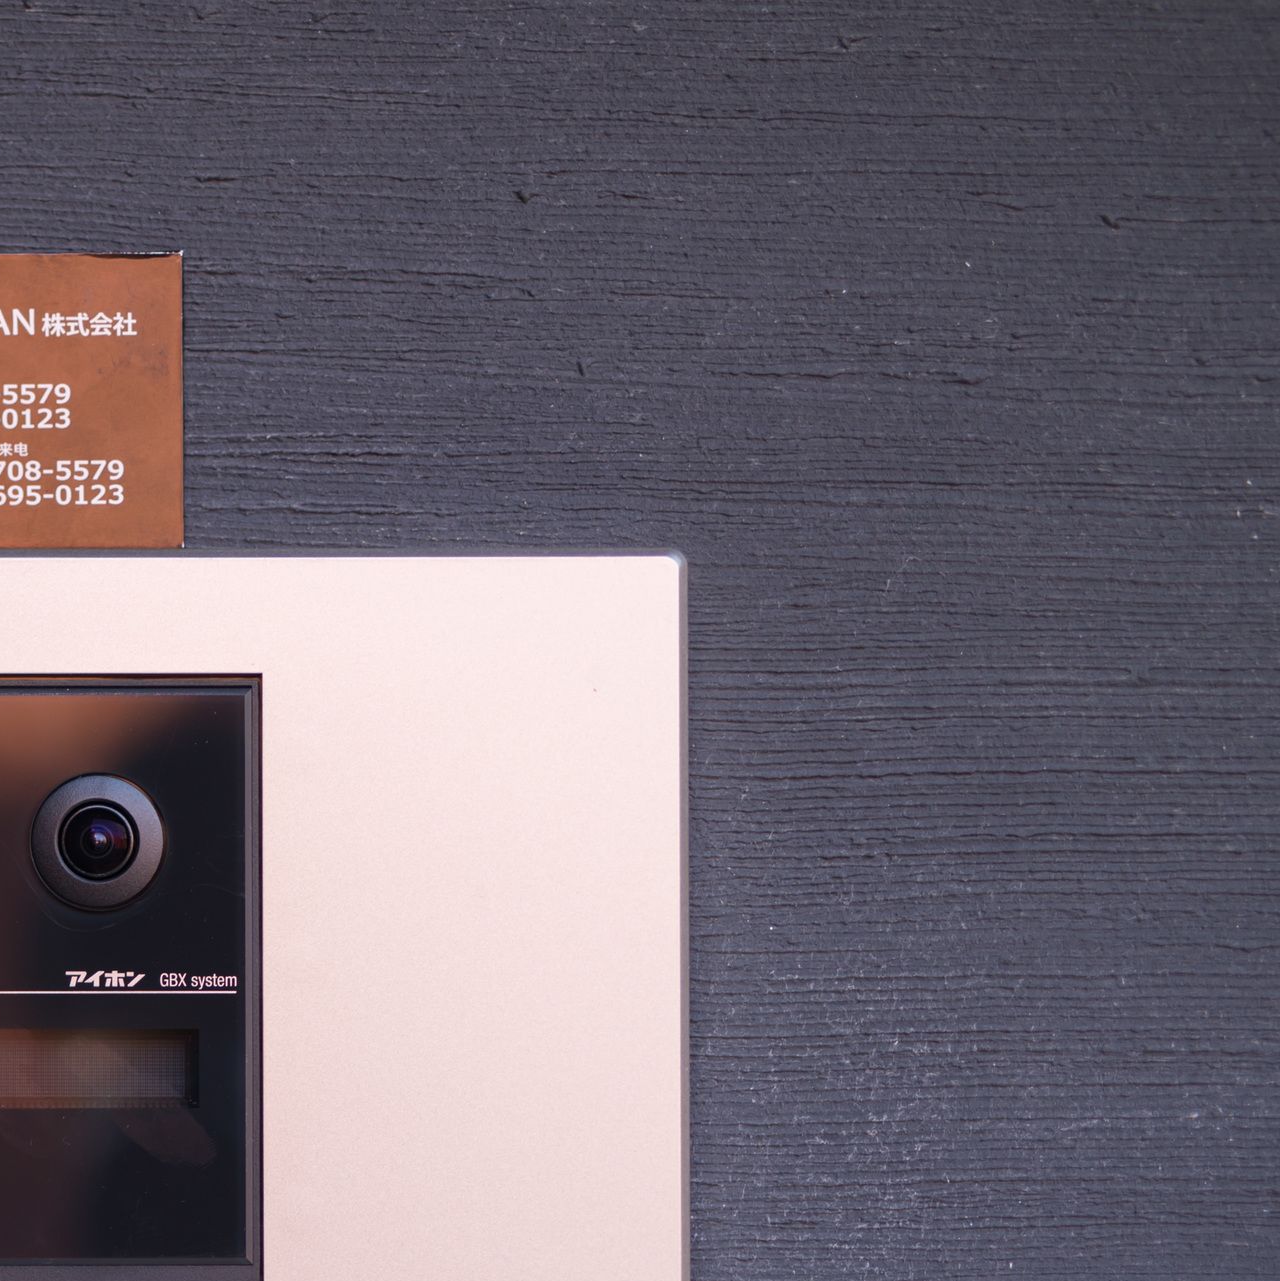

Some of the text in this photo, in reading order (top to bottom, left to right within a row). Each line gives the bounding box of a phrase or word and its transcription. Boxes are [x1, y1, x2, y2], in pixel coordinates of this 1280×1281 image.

[41, 311, 138, 338] 株式会社
[65, 970, 238, 990] アイホン GBX system
